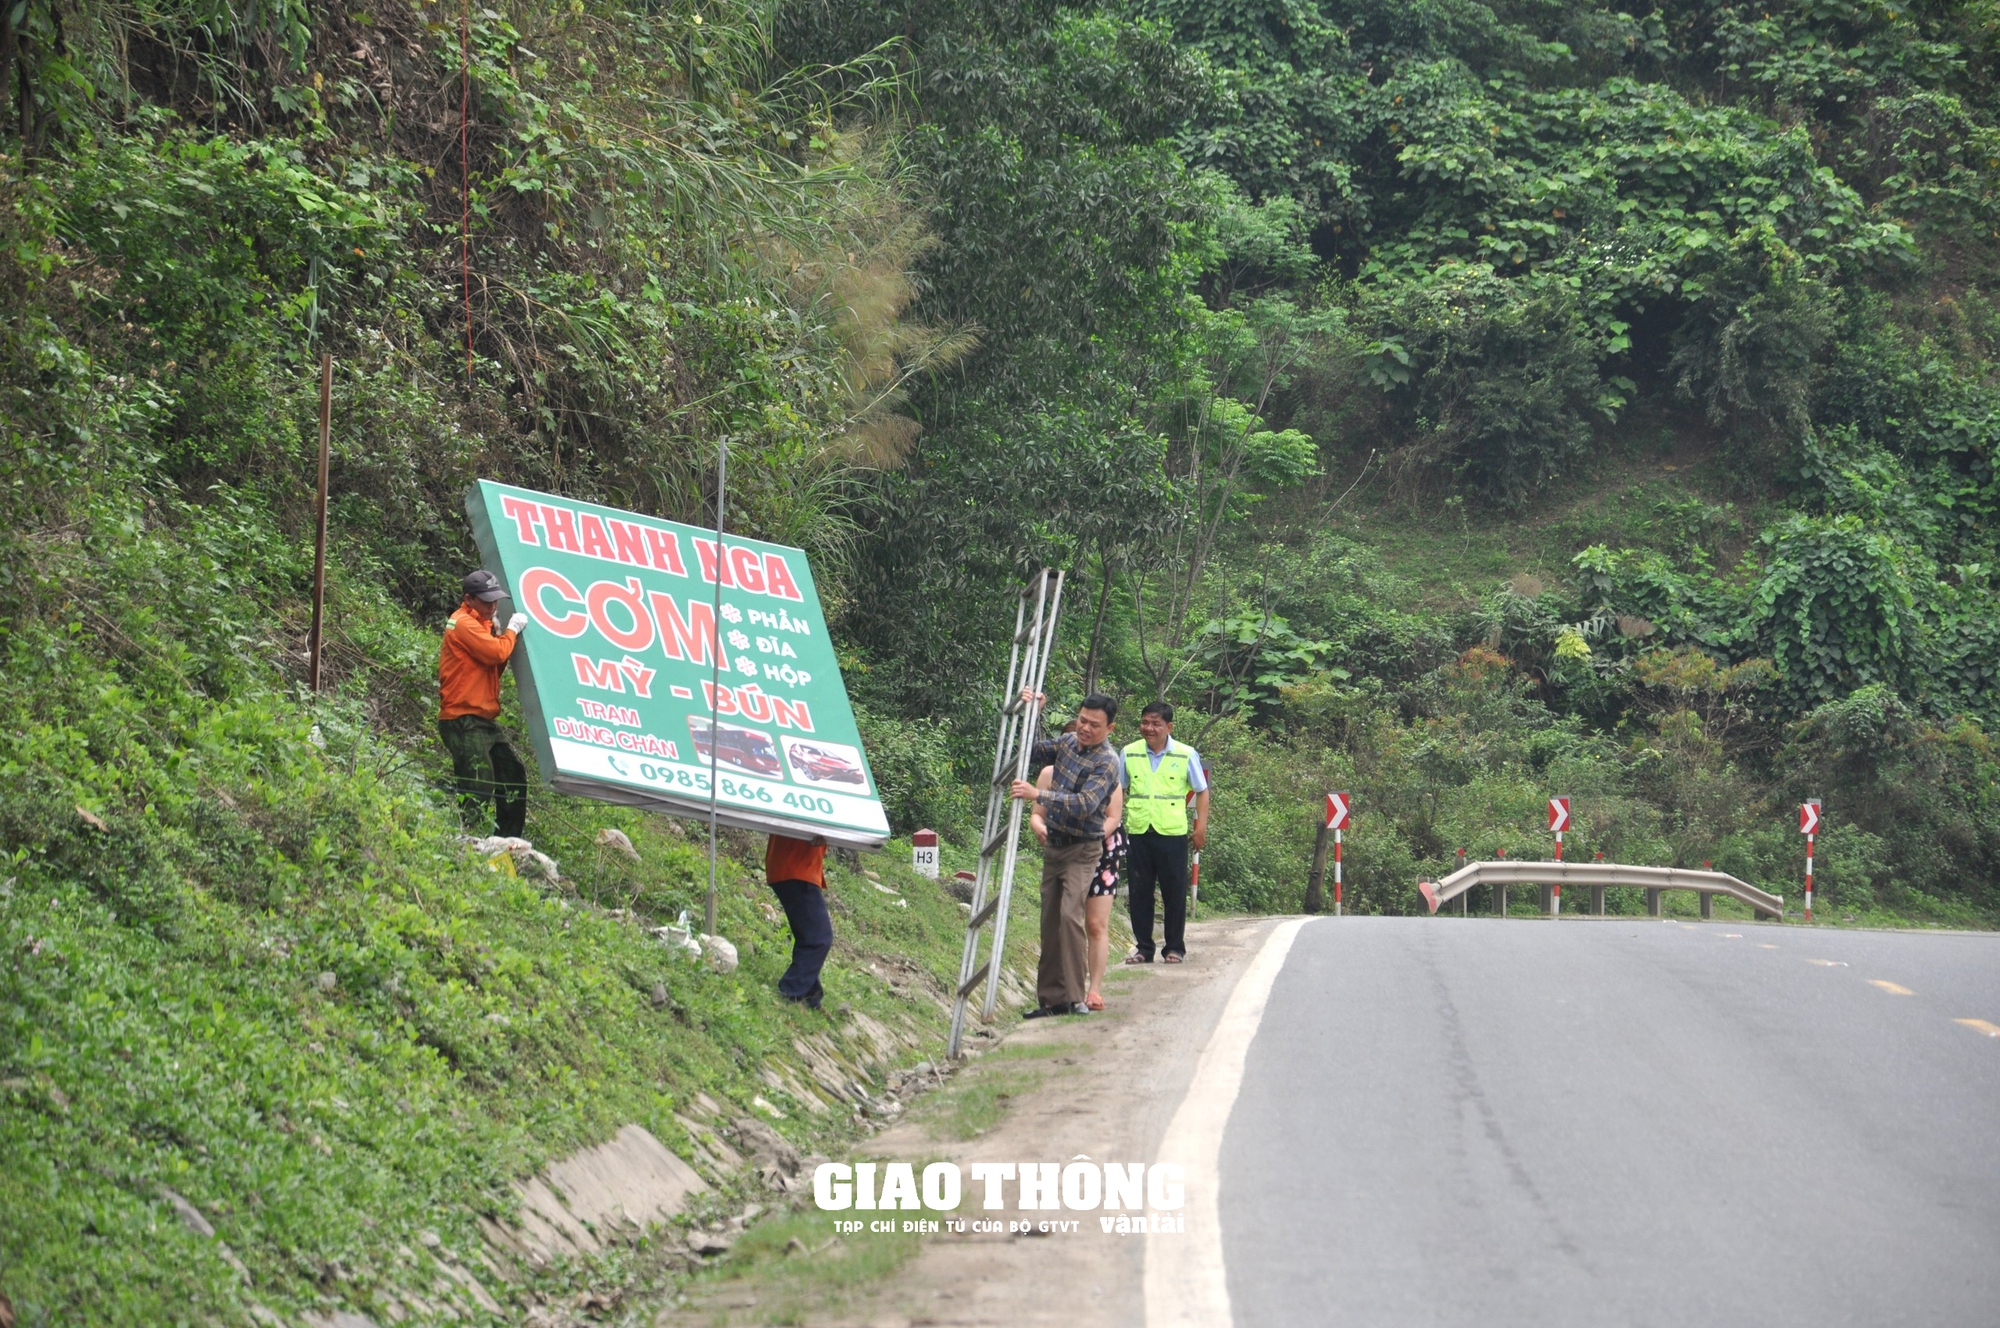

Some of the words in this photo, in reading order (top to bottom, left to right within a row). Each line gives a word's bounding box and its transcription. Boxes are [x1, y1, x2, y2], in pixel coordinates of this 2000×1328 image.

[500, 494, 688, 578] THANH
[693, 536, 804, 602] NGA
[519, 566, 731, 672] CƠM
[747, 608, 811, 635] PHẦN
[756, 635, 797, 659] ĐĨA
[763, 663, 812, 688] HỘP
[570, 652, 657, 699] MỲ
[700, 679, 815, 733] BÚN
[576, 697, 641, 728] TRẠM
[616, 734, 679, 760] CHÂN
[640, 763, 712, 791] 0985
[721, 778, 773, 804] 866
[783, 792, 834, 815] 400
[916, 851, 933, 864] H3
